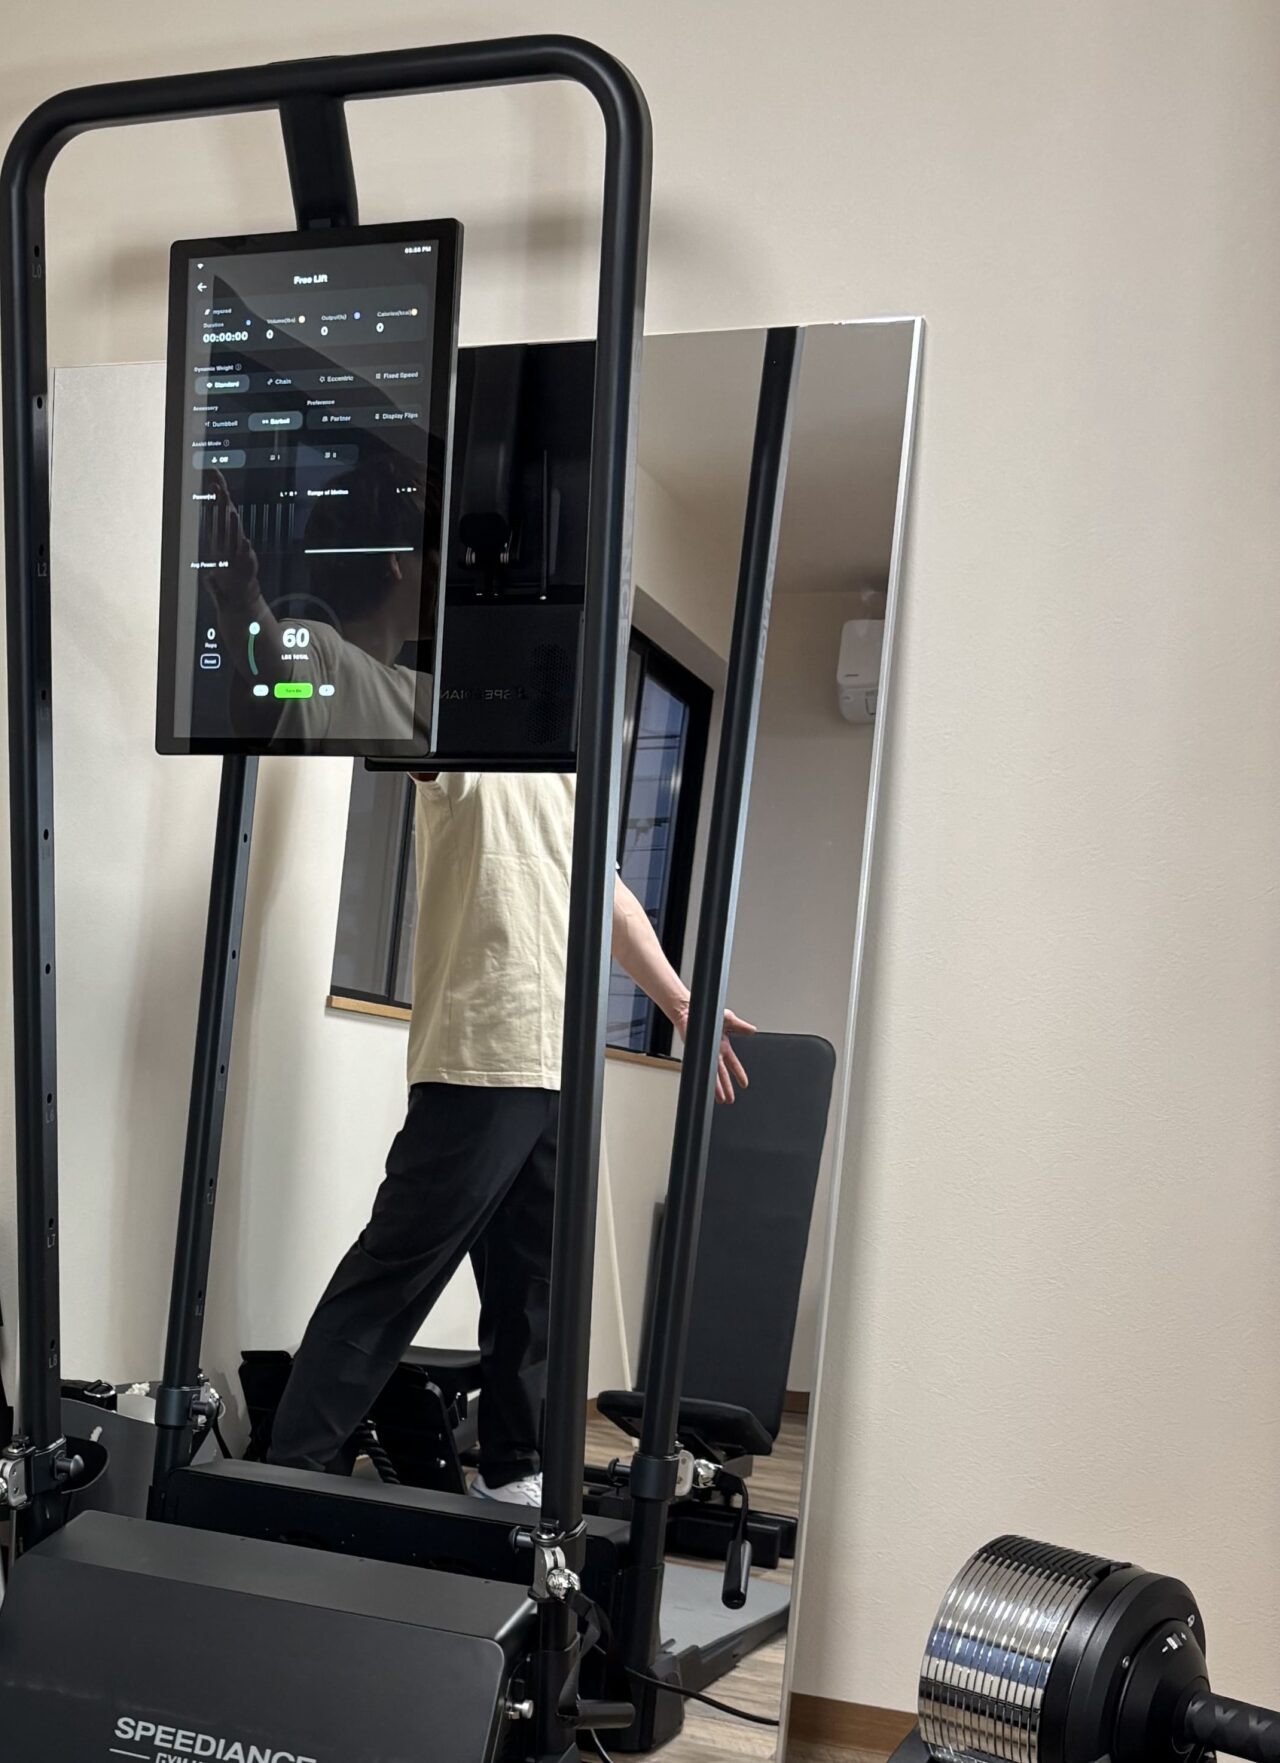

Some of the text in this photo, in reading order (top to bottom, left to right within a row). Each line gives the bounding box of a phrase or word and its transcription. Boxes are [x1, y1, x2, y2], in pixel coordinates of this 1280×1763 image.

[293, 274, 328, 285] Free Lift
[320, 326, 328, 336] 0
[376, 322, 384, 333] 0
[202, 331, 248, 343] 00:00:00
[266, 329, 274, 339] 0
[207, 628, 216, 640] 0
[282, 627, 310, 648] 60
